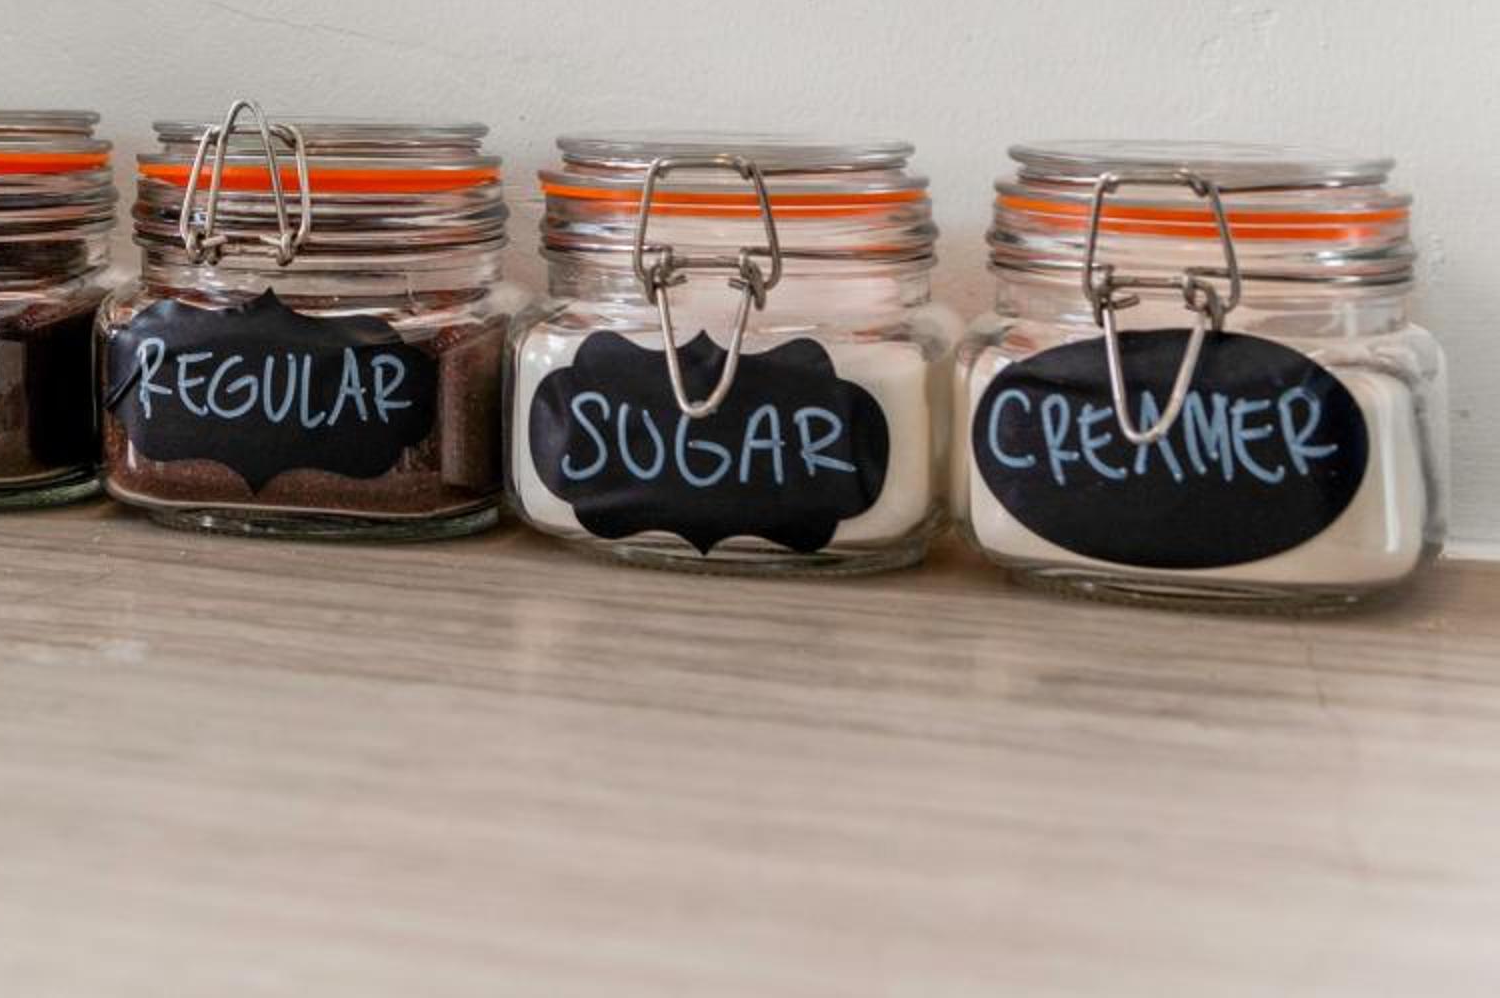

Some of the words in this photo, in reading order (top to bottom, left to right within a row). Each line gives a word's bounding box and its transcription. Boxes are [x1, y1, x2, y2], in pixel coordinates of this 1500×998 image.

[135, 337, 413, 429] REGULAR
[561, 391, 856, 487] SUGAR
[987, 386, 1338, 485] CREAMER
